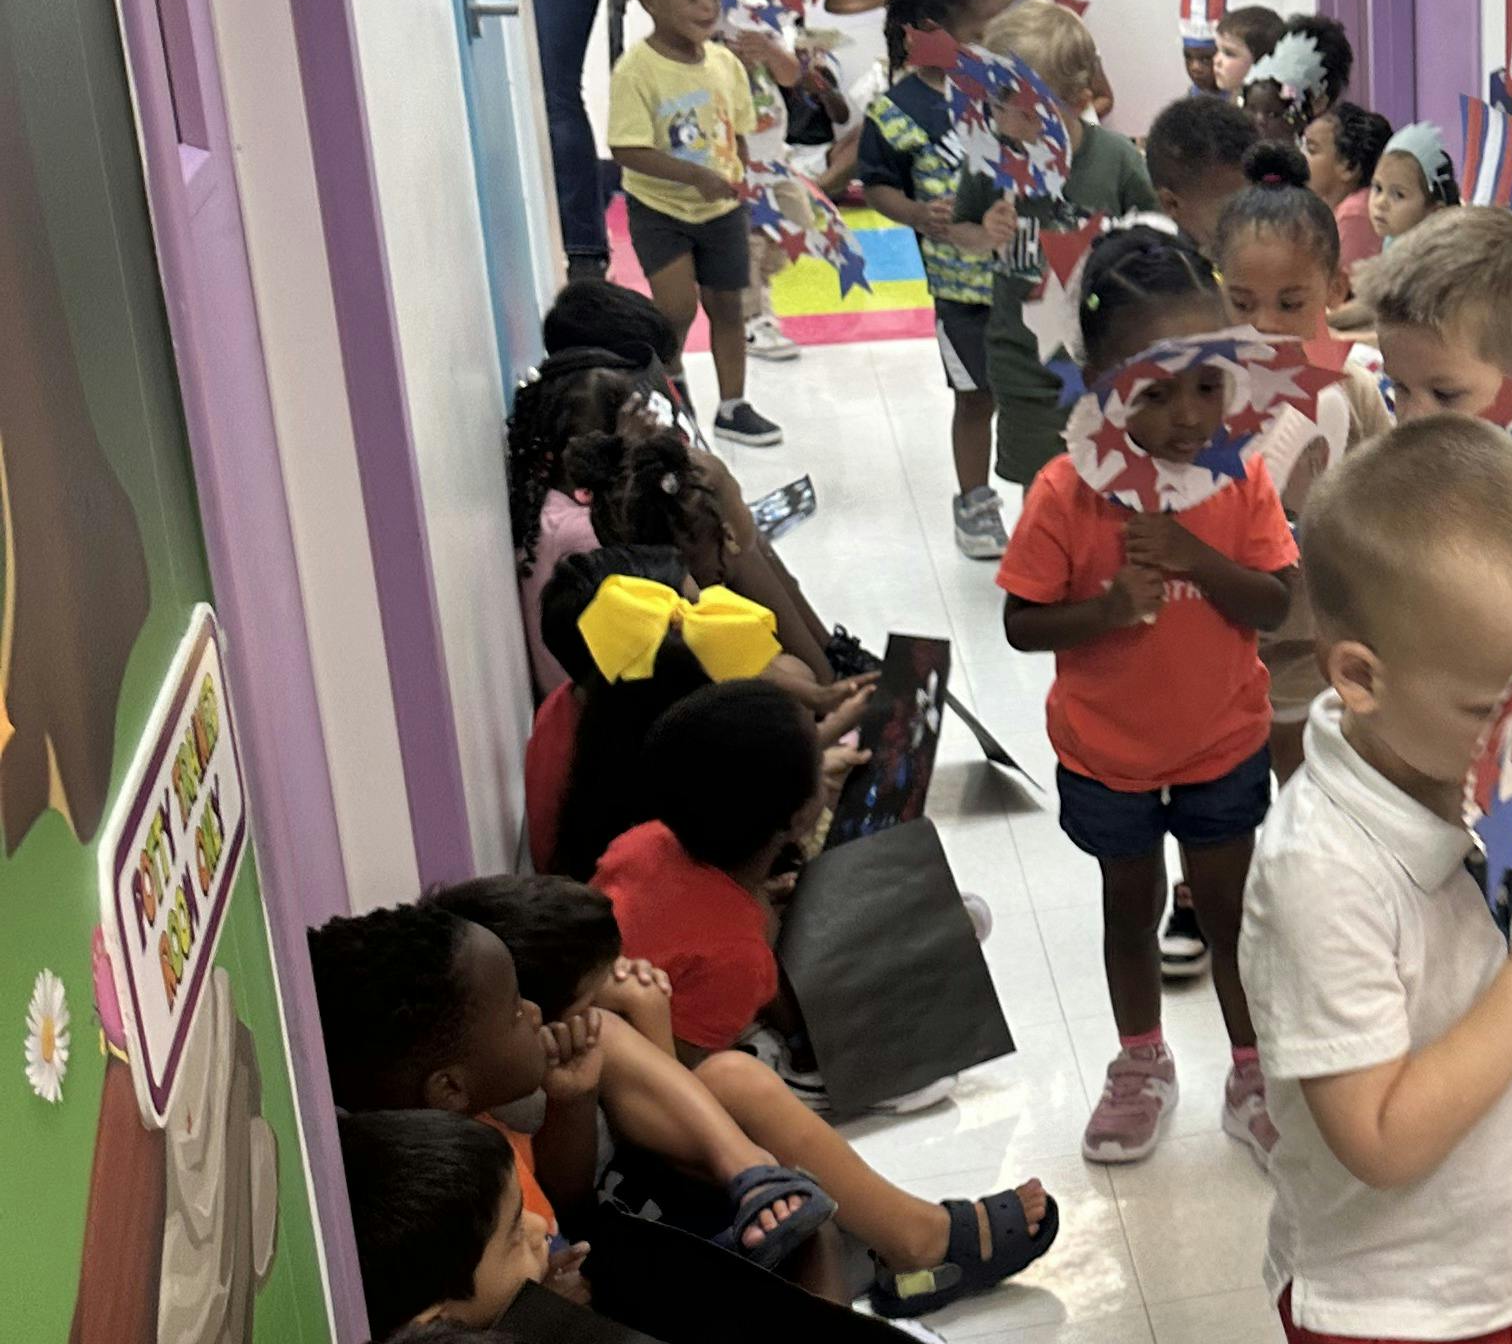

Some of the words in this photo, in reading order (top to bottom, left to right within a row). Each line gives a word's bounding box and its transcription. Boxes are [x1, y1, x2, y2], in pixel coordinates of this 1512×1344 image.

[131, 787, 176, 953] POTTY
[158, 862, 200, 1013] ROOM
[194, 772, 225, 897] ONLY
